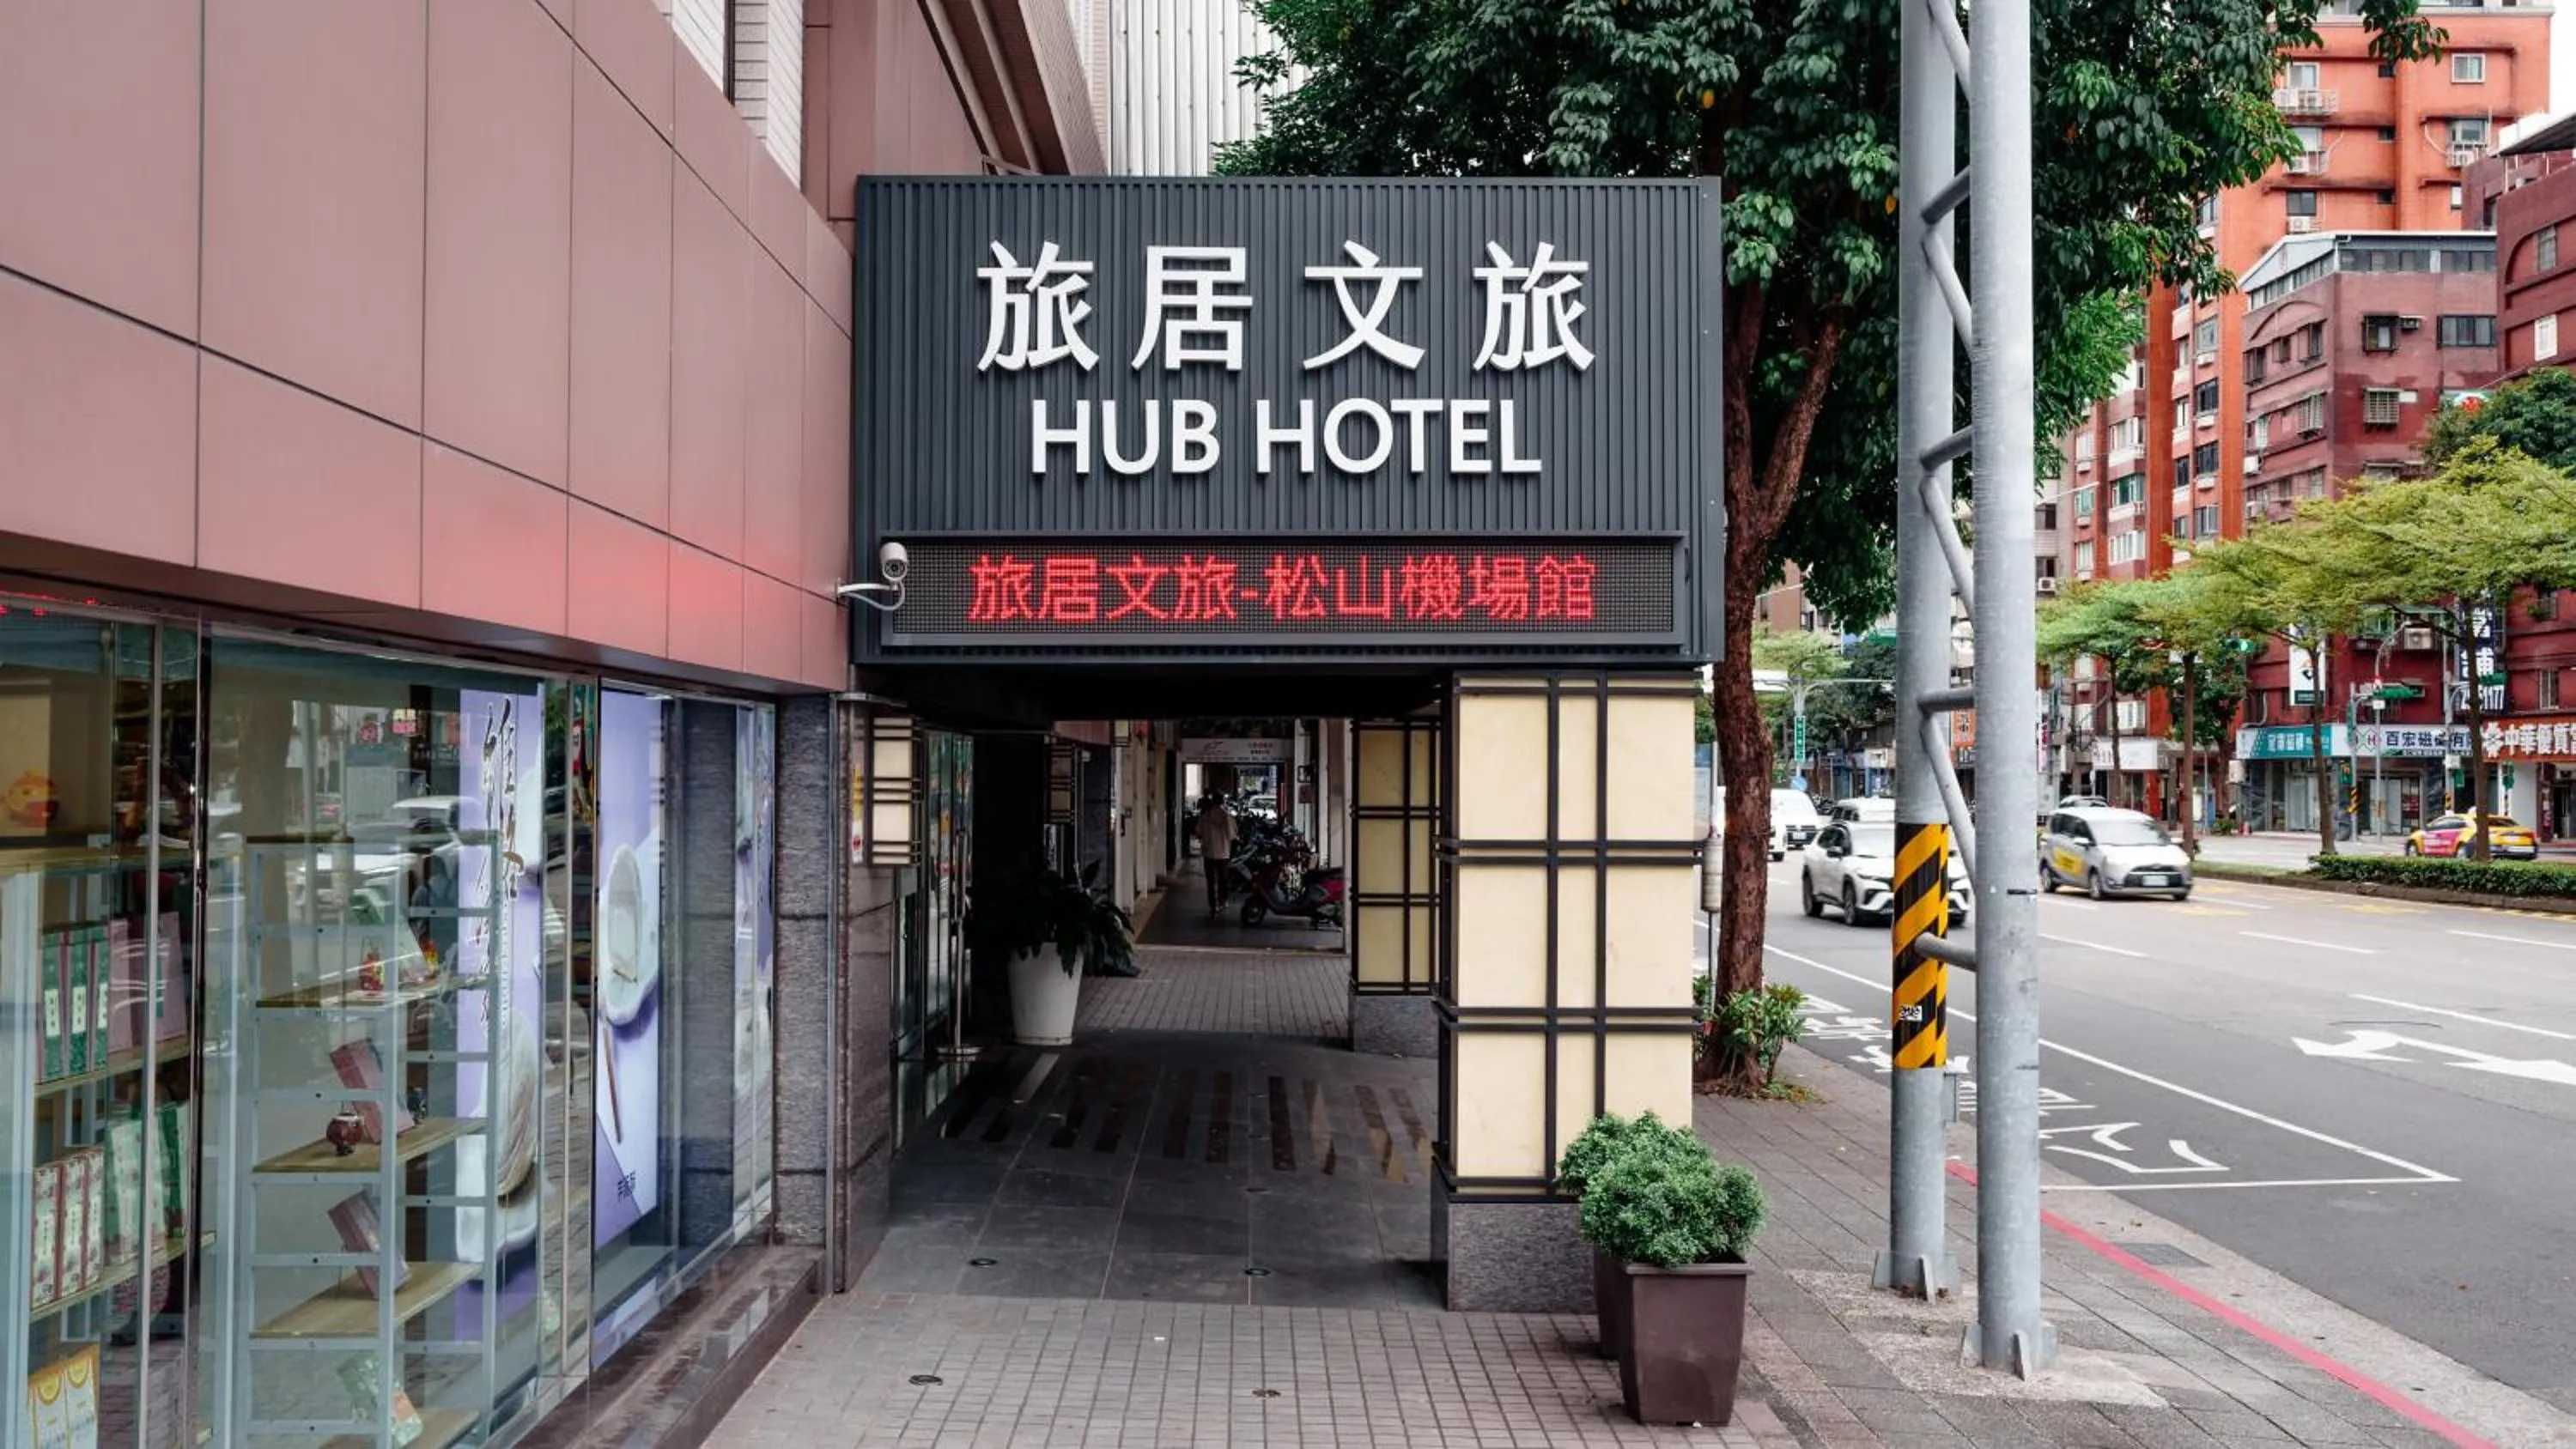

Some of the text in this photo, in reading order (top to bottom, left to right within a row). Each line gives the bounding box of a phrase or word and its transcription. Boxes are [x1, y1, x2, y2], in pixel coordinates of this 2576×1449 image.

[977, 240, 1595, 372] 旅居文旅
[1033, 397, 1542, 475] HUB HOTEL
[968, 555, 1595, 621] 旅居文旅-松山機場館
